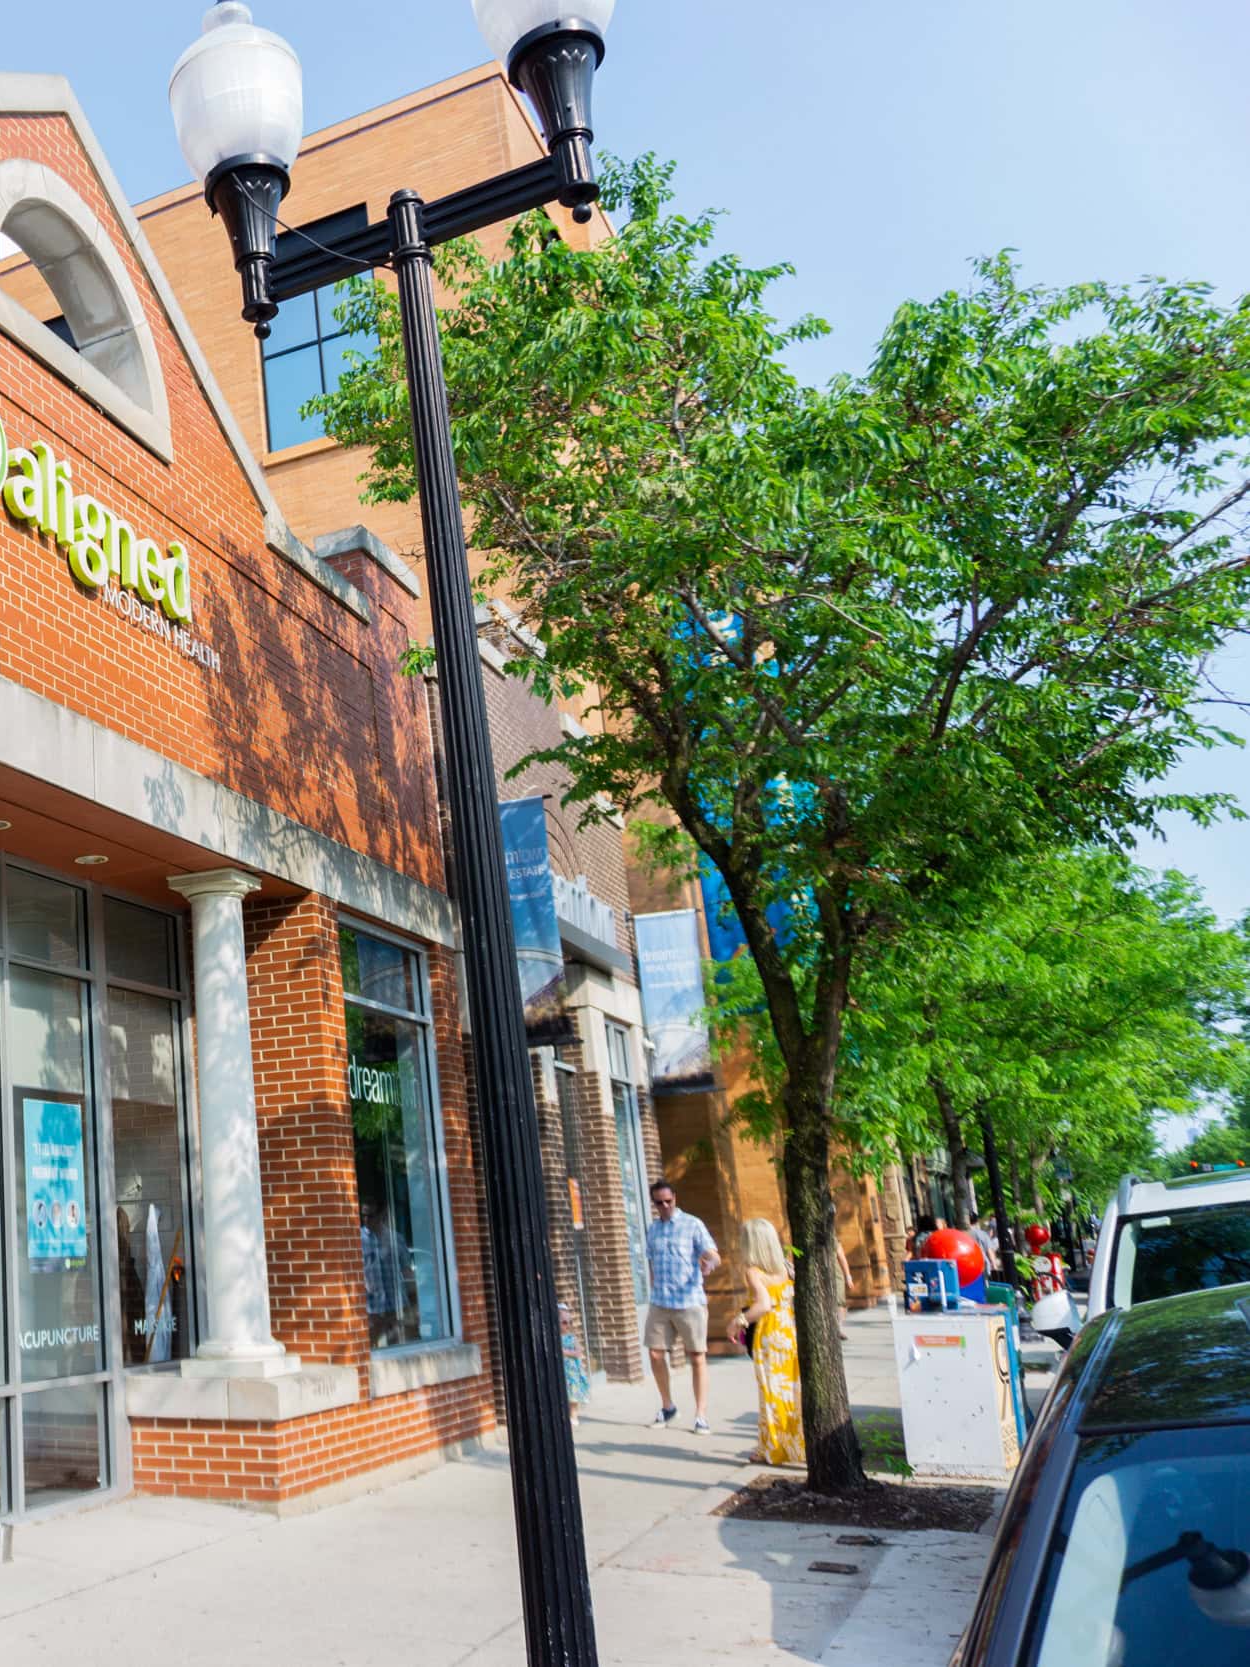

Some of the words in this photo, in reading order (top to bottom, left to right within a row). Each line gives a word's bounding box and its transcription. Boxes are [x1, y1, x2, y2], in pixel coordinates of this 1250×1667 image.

[4, 440, 193, 625] aligned
[102, 583, 172, 643] MODERN
[170, 626, 221, 673] HEALTH
